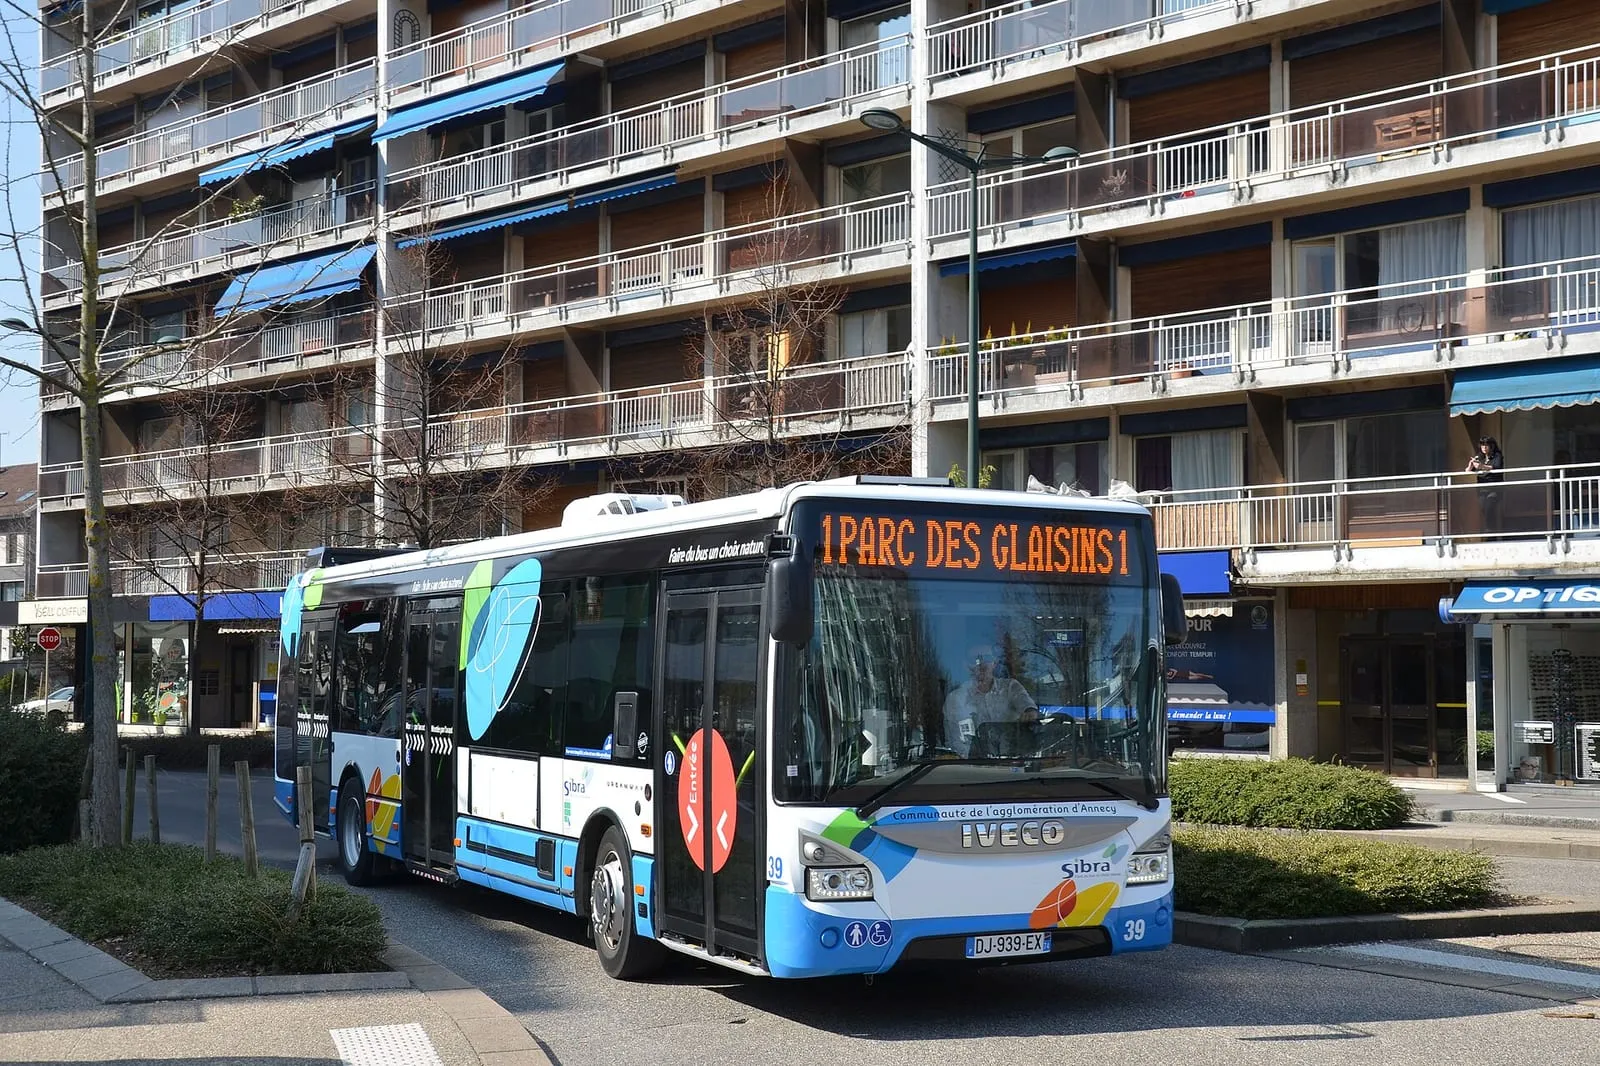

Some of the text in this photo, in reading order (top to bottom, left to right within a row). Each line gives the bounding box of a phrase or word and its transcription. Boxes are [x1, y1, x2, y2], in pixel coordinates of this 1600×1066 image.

[668, 547, 686, 563] Faire
[685, 545, 695, 562] du
[695, 544, 709, 561] bus
[709, 547, 719, 560] un
[719, 540, 740, 559] choix
[822, 514, 1128, 575] 1 PARC DES GLAISINS 1
[40, 635, 59, 643] STOP
[689, 741, 698, 804] Entrée
[564, 778, 586, 796] Sibra
[892, 802, 1118, 821] Communauté de l'agglomération d'Annecy
[961, 820, 1066, 849] IVECO
[768, 855, 783, 880] 39
[1061, 857, 1111, 879] Sibra
[1123, 918, 1146, 942] 39
[975, 934, 1042, 954] DJ-939-EX
